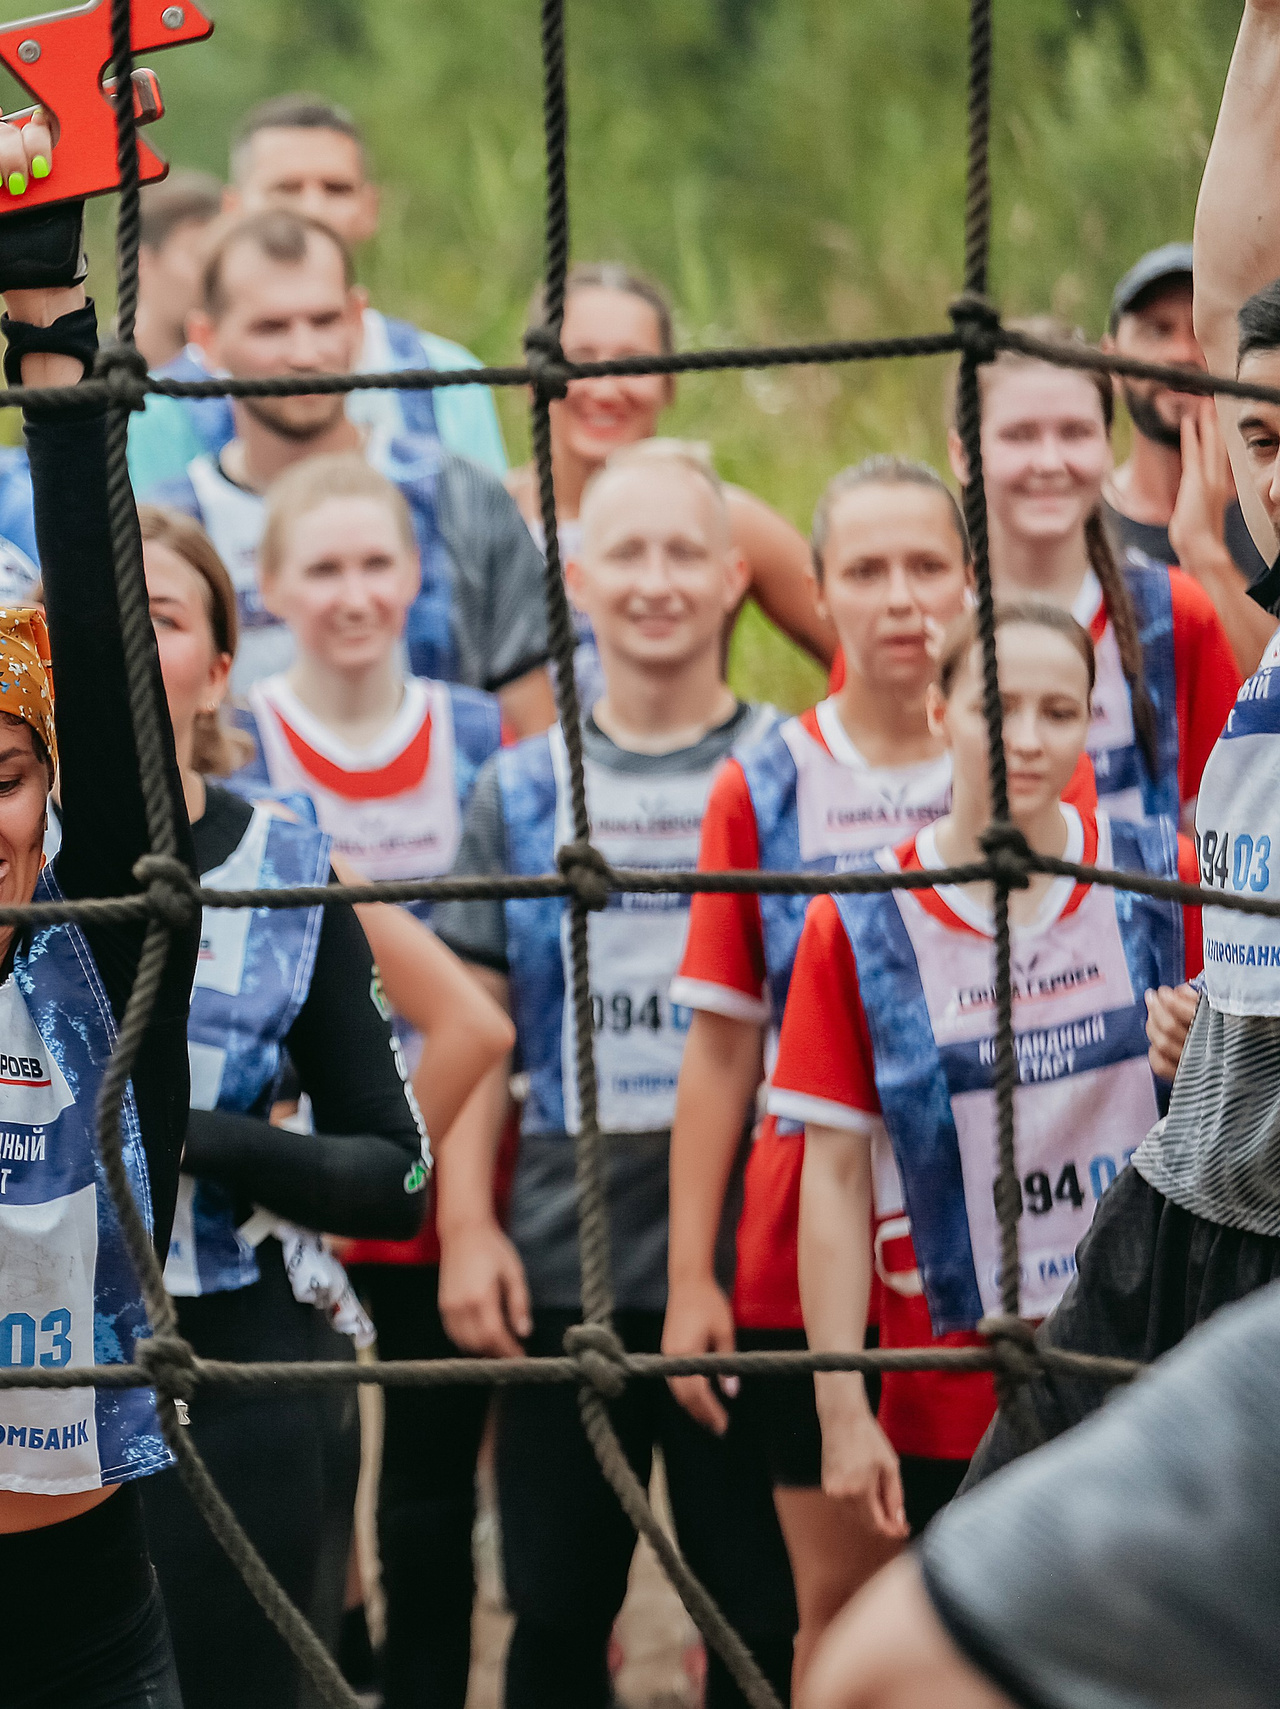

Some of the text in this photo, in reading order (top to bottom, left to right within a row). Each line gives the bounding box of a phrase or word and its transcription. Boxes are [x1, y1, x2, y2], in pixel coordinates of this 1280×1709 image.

[1197, 829, 1271, 892] 9403
[959, 980, 1022, 1010] ГОНА
[1022, 1148, 1136, 1217] 940
